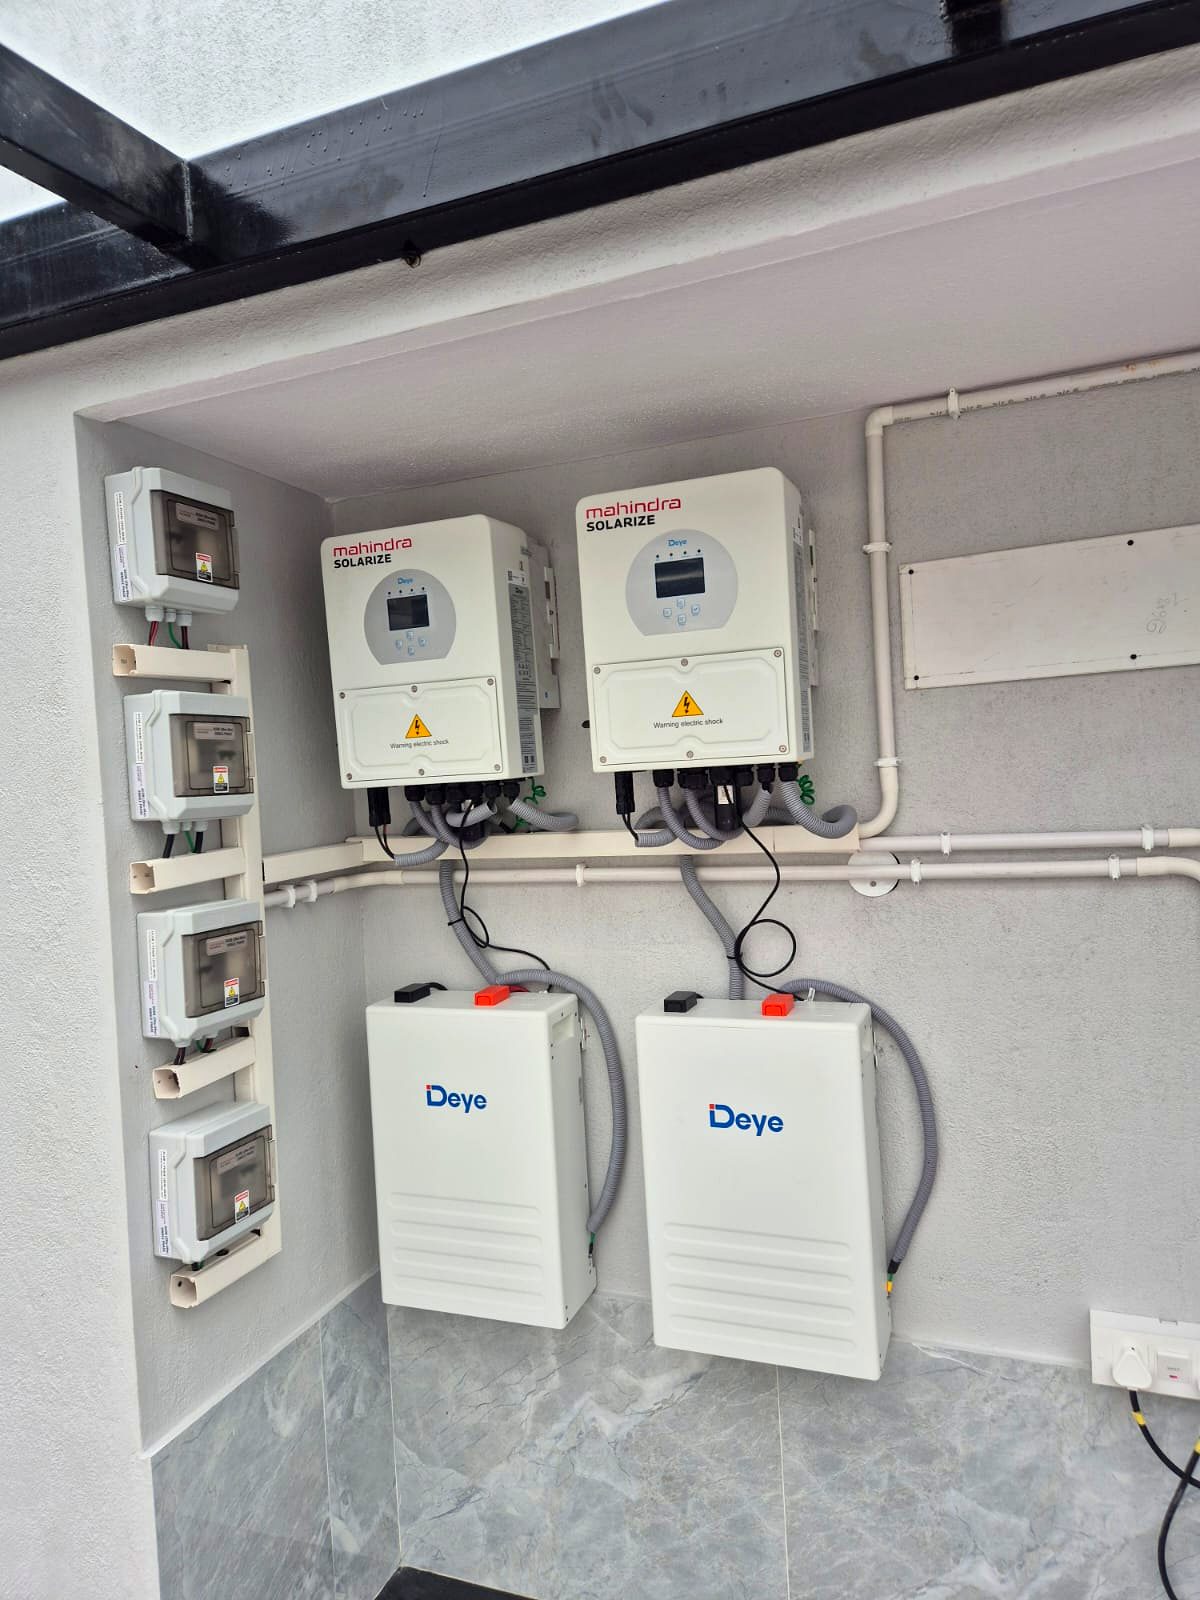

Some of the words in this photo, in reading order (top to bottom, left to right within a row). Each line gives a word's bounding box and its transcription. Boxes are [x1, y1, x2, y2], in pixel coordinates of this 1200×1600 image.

[586, 498, 681, 519] mahindra
[586, 515, 655, 531] SOLARIZE
[333, 538, 412, 557] mahindra
[668, 539, 688, 547] Deye
[334, 554, 392, 568] SOLARIZE
[653, 721, 679, 729] Warning
[681, 719, 703, 727] electric
[426, 1084, 487, 1113] Deye
[709, 1104, 784, 1136] Deye
